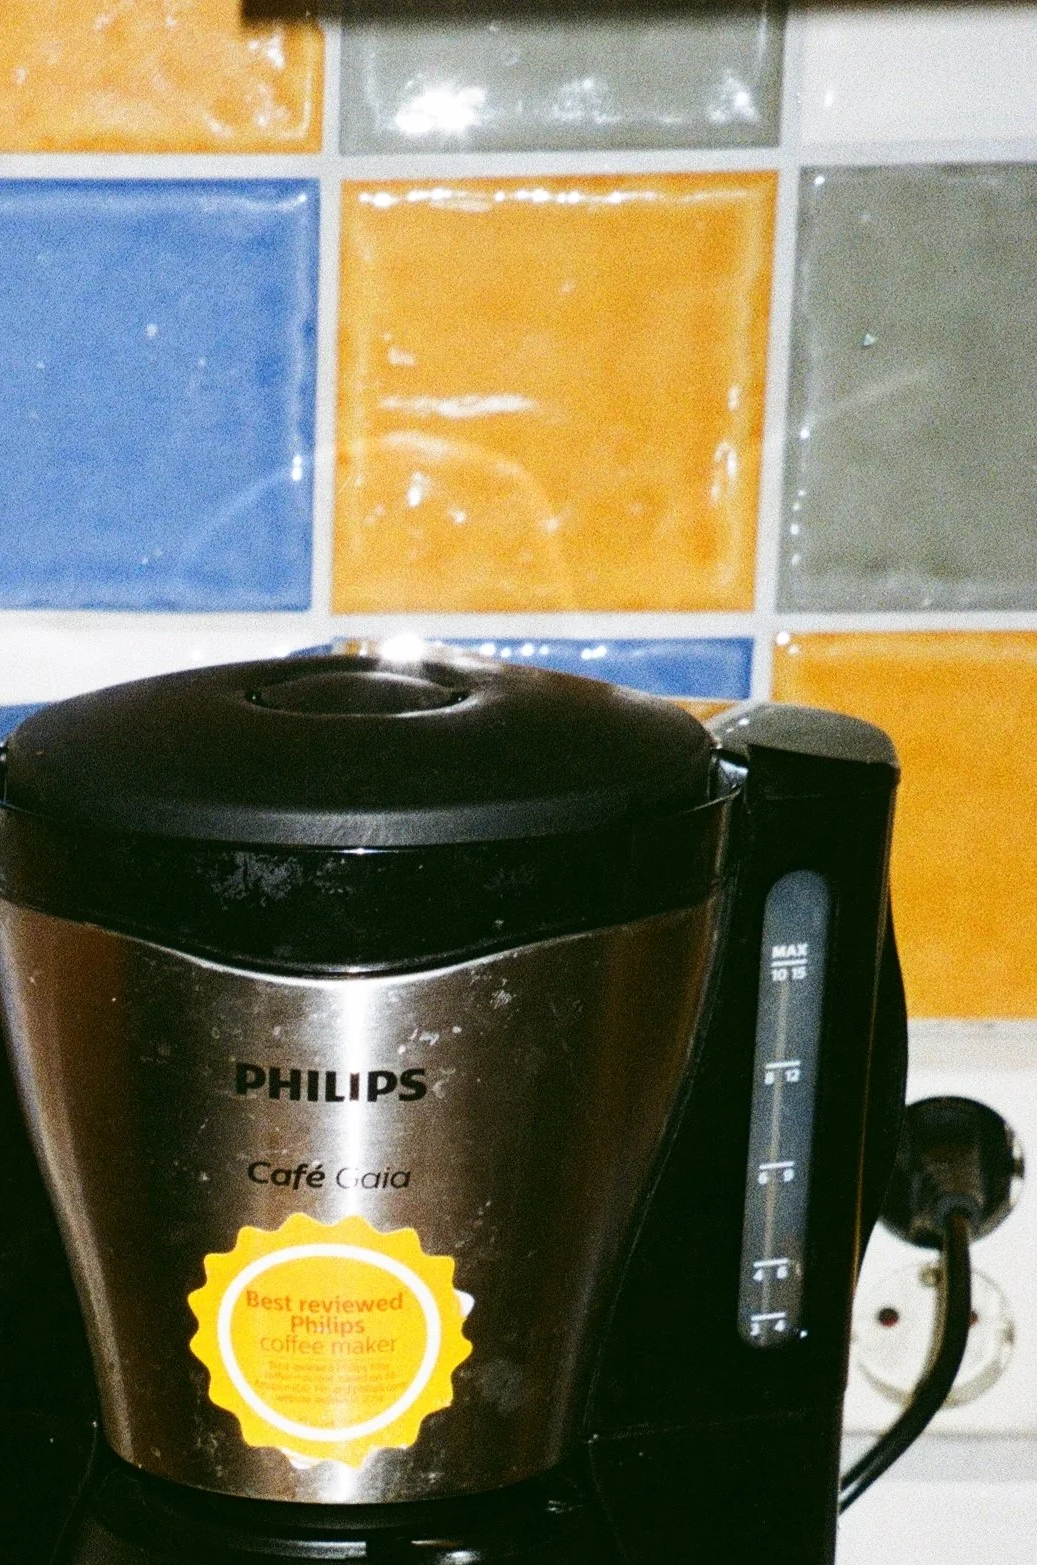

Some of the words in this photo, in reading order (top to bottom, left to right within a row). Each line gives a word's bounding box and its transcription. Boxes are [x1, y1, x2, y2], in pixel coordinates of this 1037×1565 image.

[772, 943, 808, 958] MAX
[772, 968, 787, 981] 10
[792, 966, 806, 980] 15
[235, 1062, 428, 1102] PHILIPS
[785, 1069, 800, 1082] 12
[247, 1161, 326, 1190] Café
[336, 1166, 412, 1189] Gaia
[246, 1290, 293, 1312] Best
[299, 1292, 404, 1313] reviewed
[290, 1315, 366, 1337] Philips
[260, 1335, 325, 1354] coffee
[331, 1336, 398, 1355] maker
